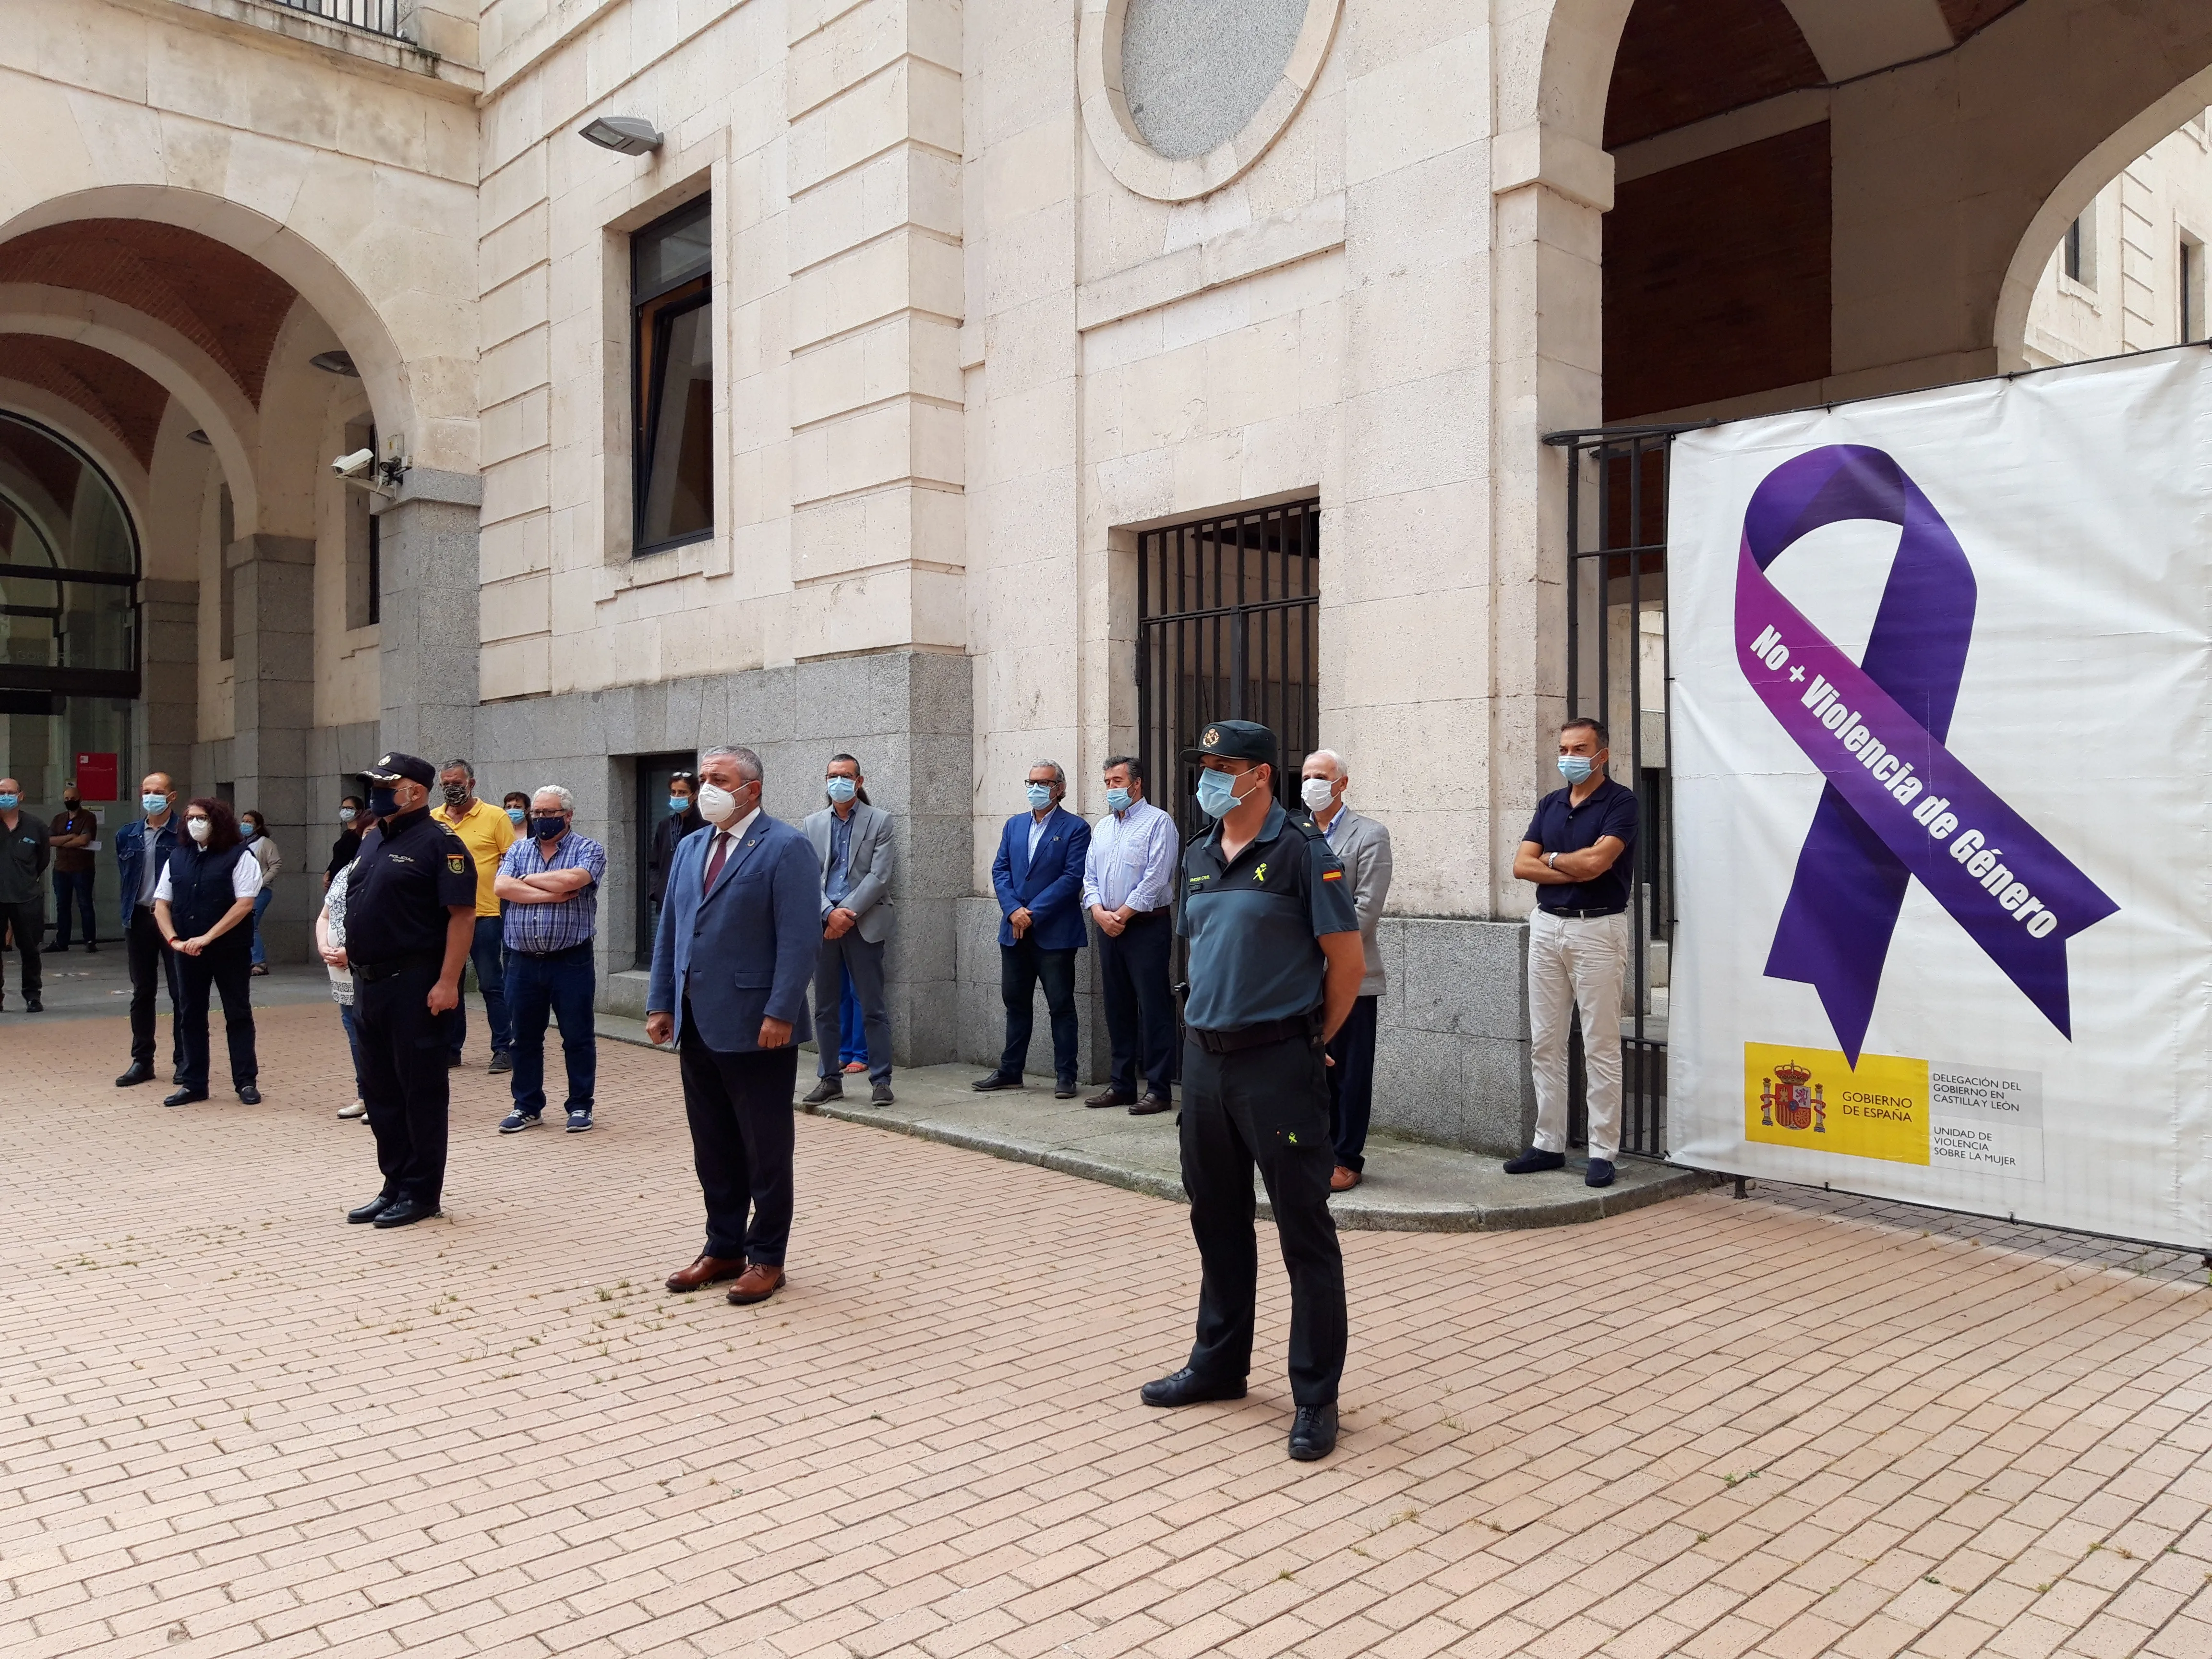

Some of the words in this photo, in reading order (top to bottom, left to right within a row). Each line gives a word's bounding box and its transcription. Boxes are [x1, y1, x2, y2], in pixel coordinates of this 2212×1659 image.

[1750, 624, 1790, 671] No
[1789, 665, 1805, 682] +
[1801, 674, 1923, 806] Violencia
[1912, 795, 1958, 840] de
[1949, 829, 2057, 938] Género
[1933, 1073, 1999, 1088] DELEGACIÓN
[2002, 1081, 2022, 1091] DEL
[1933, 1083, 1987, 1097] GOBIERNO
[1991, 1090, 2004, 1099] EN
[1842, 1091, 1912, 1108] GOBIERNO
[1934, 1094, 1980, 1107] CASTILLA
[1981, 1099, 1988, 1107] Y
[1991, 1100, 2020, 1112] LEÓN
[1843, 1105, 1860, 1116] DE
[1864, 1107, 1912, 1123] ESPAÑA
[1934, 1126, 1975, 1139] UNIDAD
[1979, 1132, 1993, 1142] DE
[1934, 1136, 1989, 1152] VIOLENCIA
[1934, 1147, 1966, 1159] SOBRE
[1969, 1152, 1982, 1161] LA
[1985, 1154, 2016, 1166] MUJER
